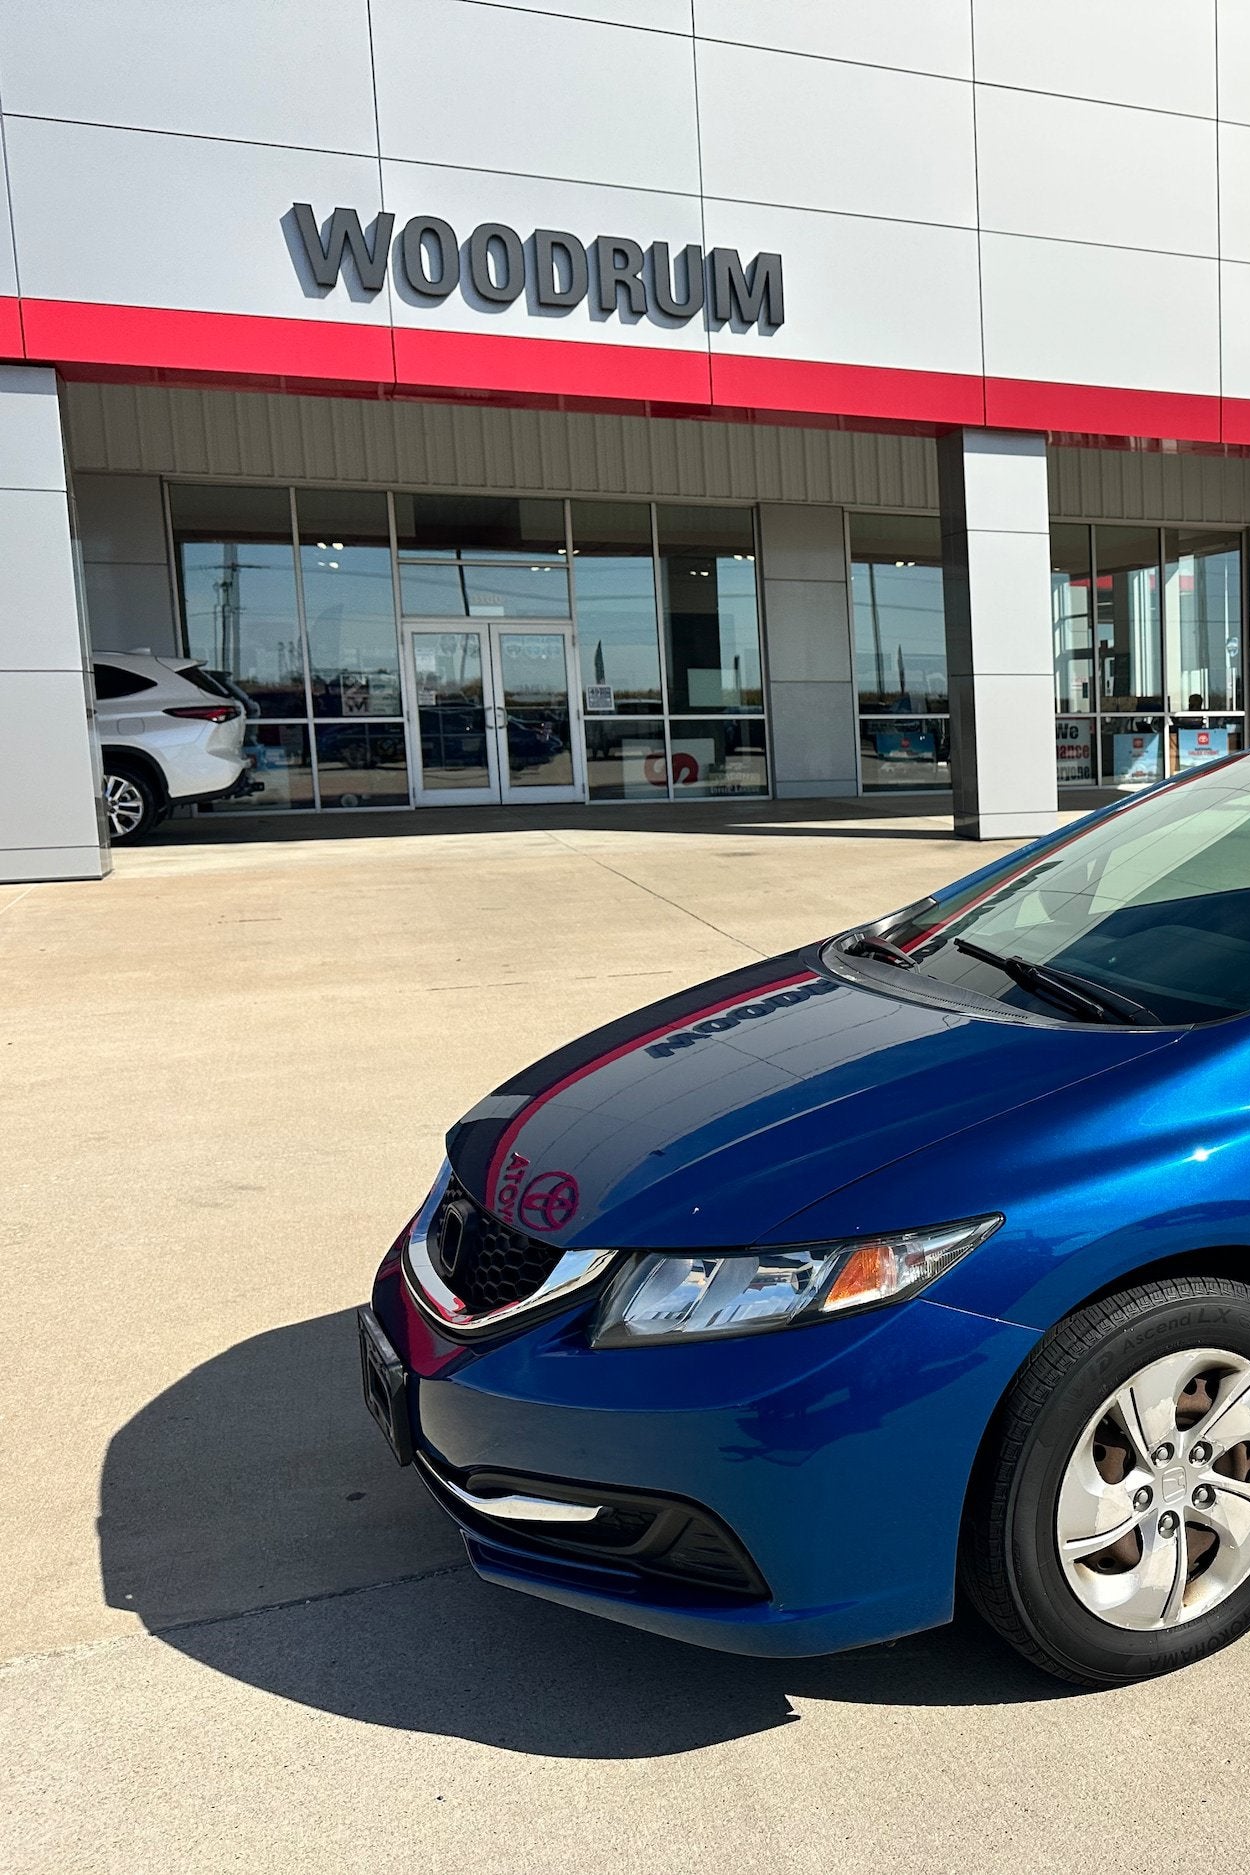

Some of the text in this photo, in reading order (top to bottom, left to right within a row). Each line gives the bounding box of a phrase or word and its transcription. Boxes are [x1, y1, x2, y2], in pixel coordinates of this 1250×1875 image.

[291, 202, 785, 326] WOODRUM
[1057, 745, 1089, 759] ance
[1122, 1312, 1192, 1354] Ascend
[1198, 1308, 1232, 1325] LX
